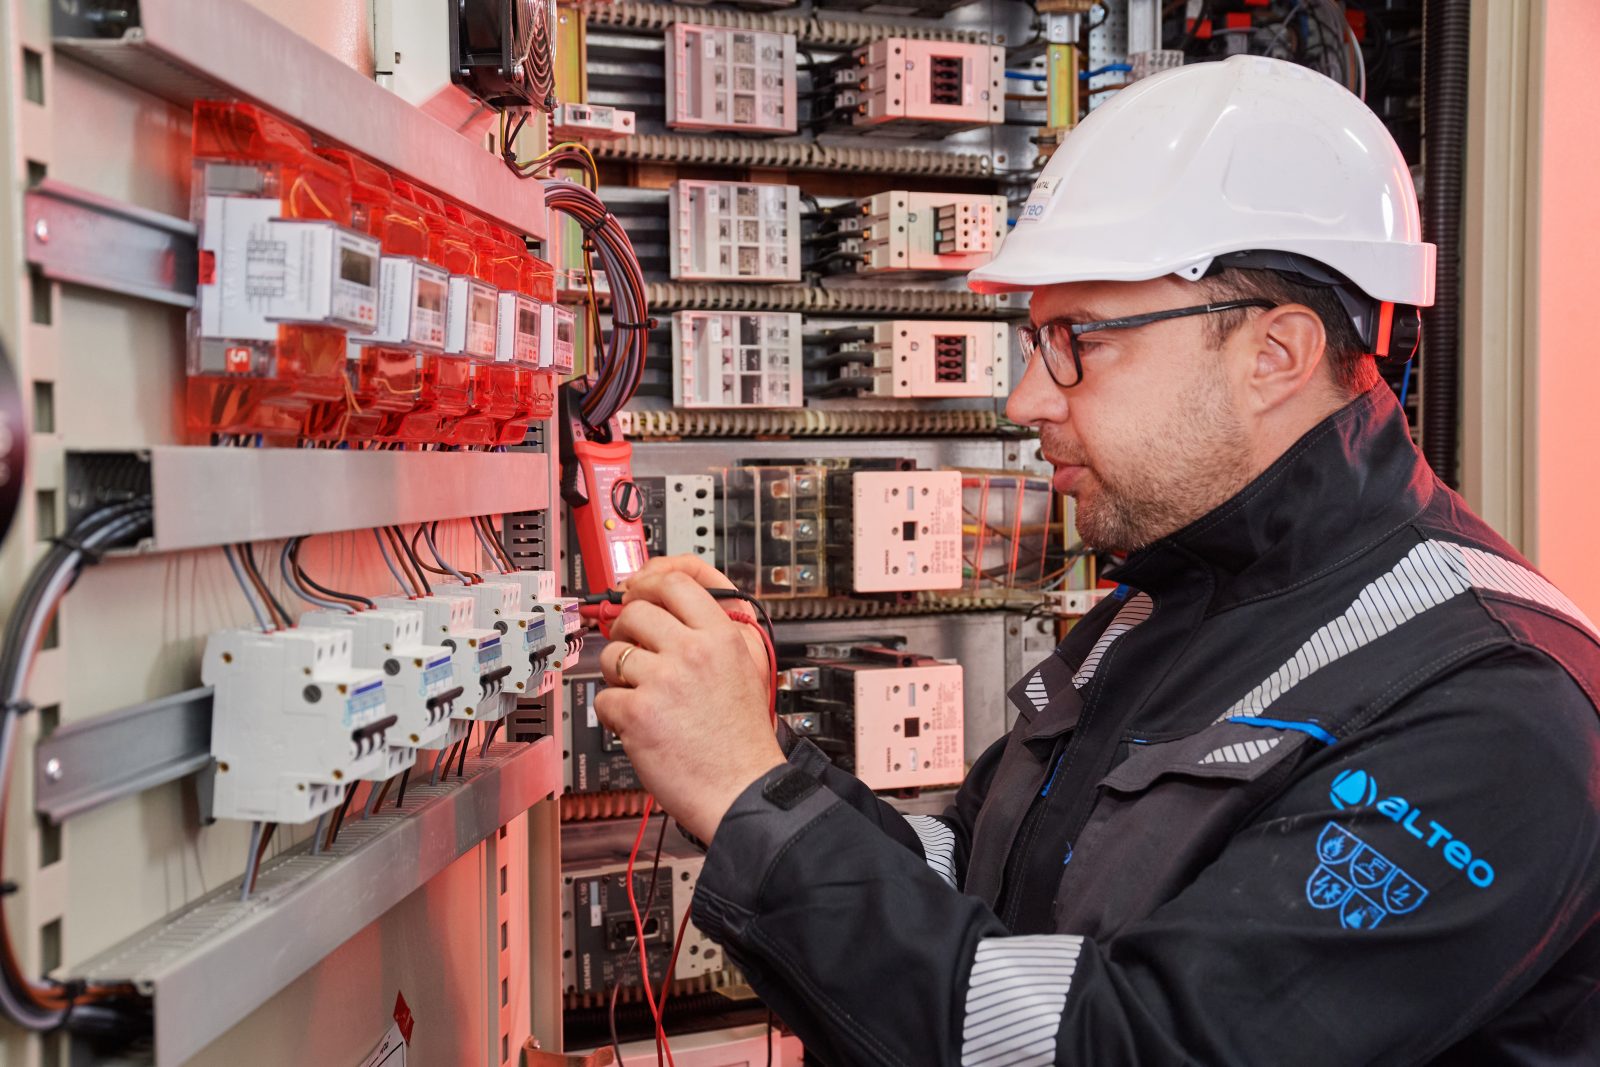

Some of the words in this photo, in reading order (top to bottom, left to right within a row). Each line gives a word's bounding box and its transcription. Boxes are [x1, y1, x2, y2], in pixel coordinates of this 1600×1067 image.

[574, 553, 583, 591] SIEMENS
[578, 753, 588, 791] SIEMENS
[582, 953, 592, 991] SIEMENS
